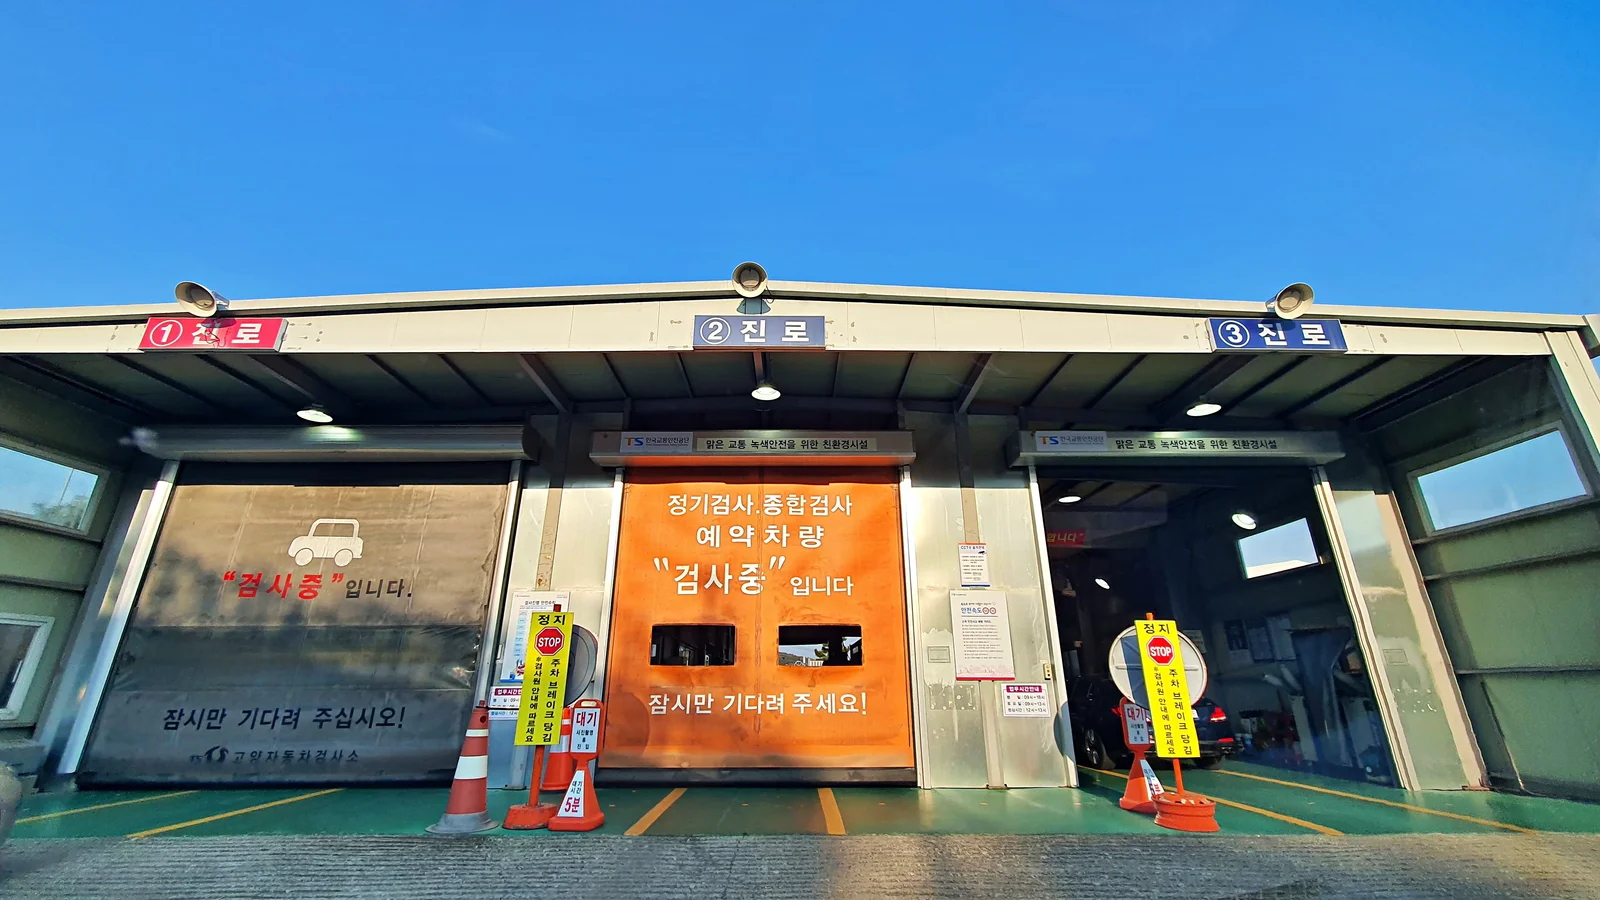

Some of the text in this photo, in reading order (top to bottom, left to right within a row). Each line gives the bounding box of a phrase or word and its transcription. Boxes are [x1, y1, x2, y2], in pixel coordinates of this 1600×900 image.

[624, 437, 644, 446] TS
[706, 439, 868, 449] 맑은 교통 녹색안전을 위한 친환경시설
[1039, 436, 1059, 445] TS
[1115, 439, 1278, 449] 맑은 교통 녹색안전을 위한 친환경시설
[538, 614, 566, 625] 정지
[1144, 624, 1170, 634] 정지
[538, 637, 561, 648] STOP
[1150, 646, 1172, 656] STOP
[542, 659, 561, 743] 주차 브레이크 당김
[648, 692, 867, 715] 잠시만 기다려 주세요!
[1127, 707, 1144, 721] 대기
[1169, 669, 1193, 755] 주차 브레이크 당김
[163, 706, 406, 730] 잠시만 기다려 주십시오!
[576, 711, 597, 727] 대기
[565, 797, 580, 812] 5분
